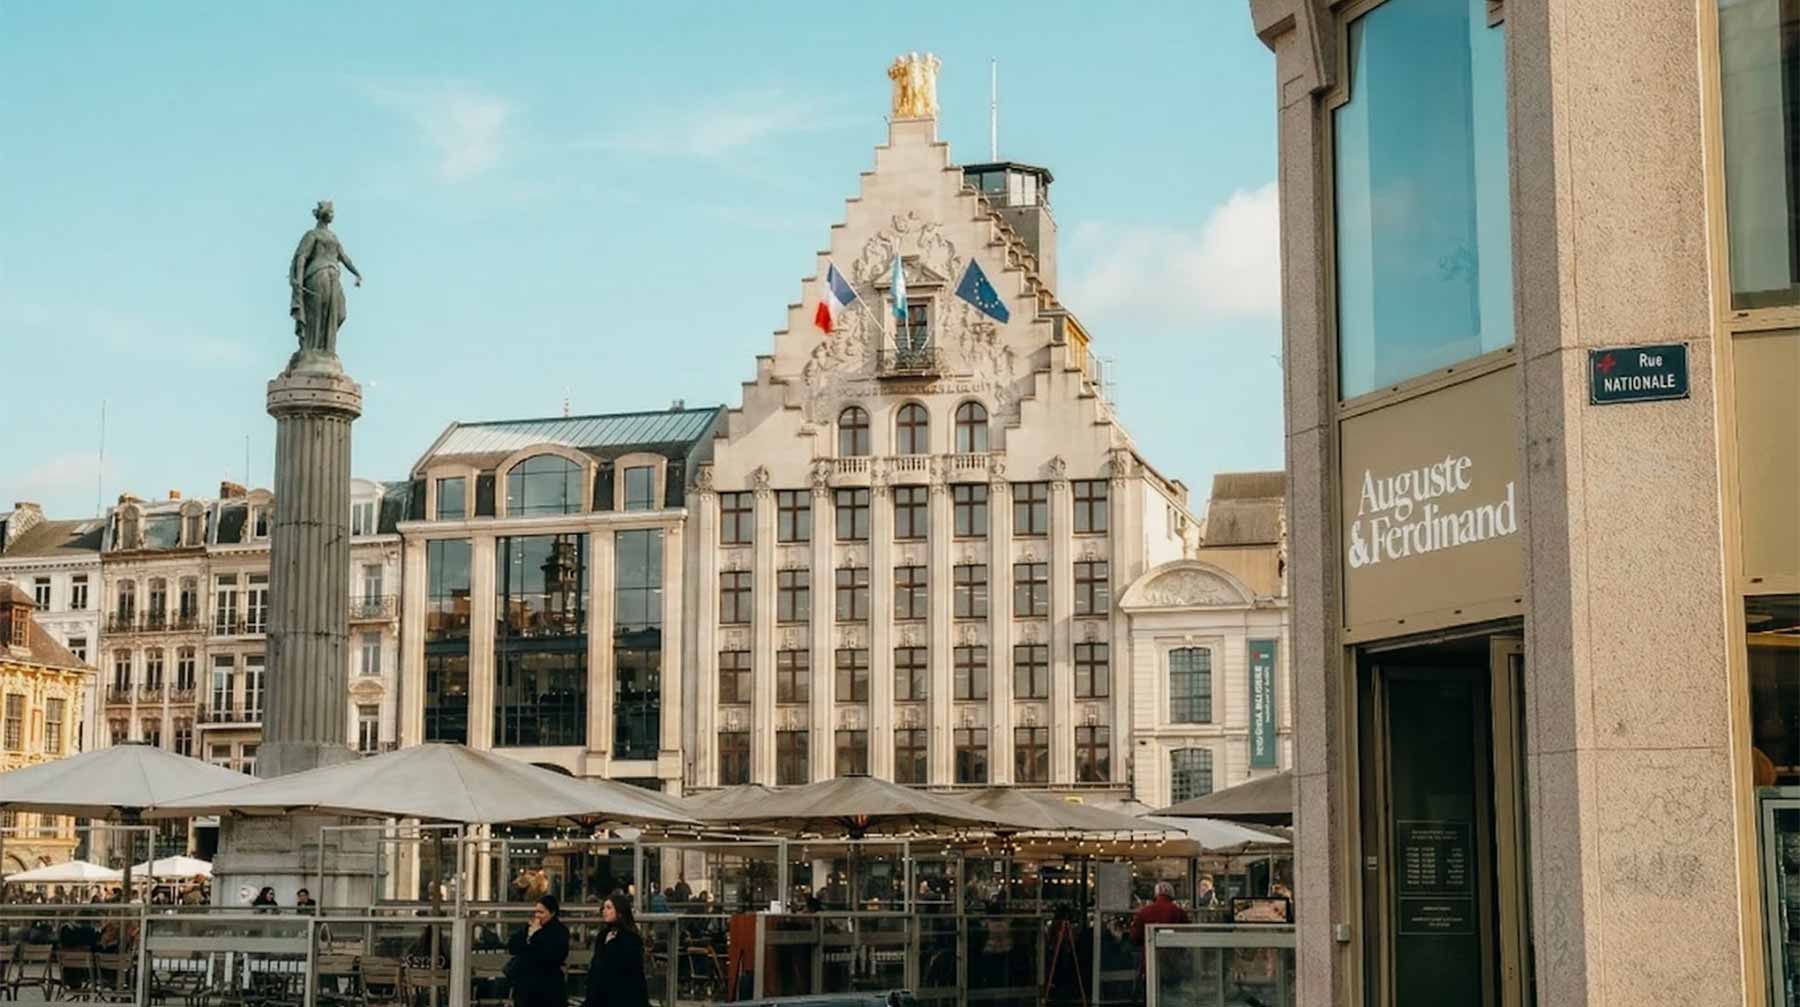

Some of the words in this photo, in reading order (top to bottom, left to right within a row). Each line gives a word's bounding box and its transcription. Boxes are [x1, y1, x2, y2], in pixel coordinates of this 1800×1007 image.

[1638, 353, 1663, 368] Rue
[1603, 374, 1676, 393] NATIONALE
[1357, 454, 1473, 522] Auguste
